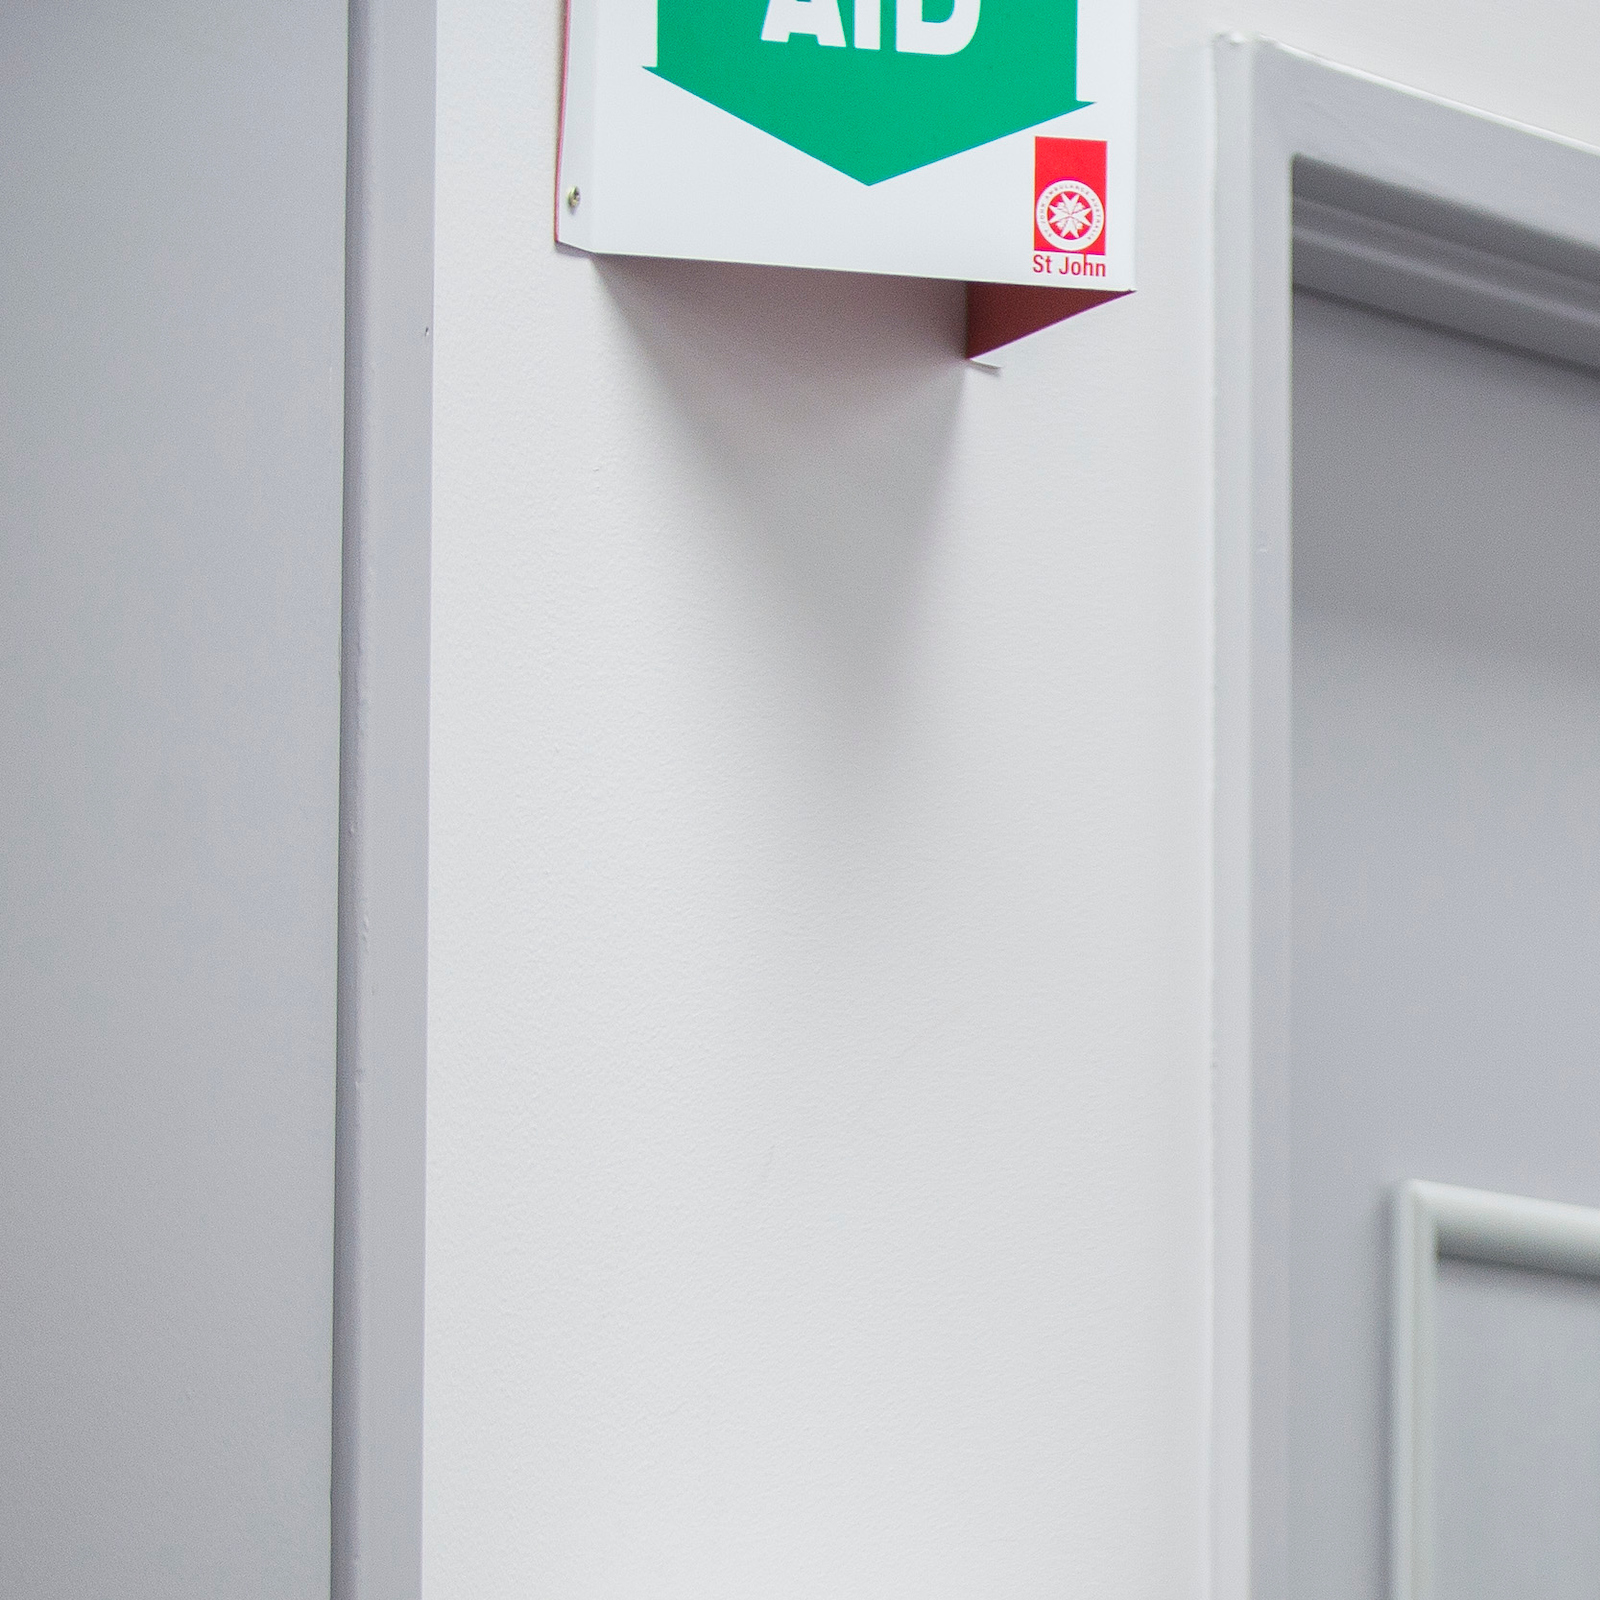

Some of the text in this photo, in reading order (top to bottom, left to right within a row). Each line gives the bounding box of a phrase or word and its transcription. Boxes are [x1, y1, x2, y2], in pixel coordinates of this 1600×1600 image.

[760, 0, 982, 56] AID
[1032, 253, 1107, 277] St John
